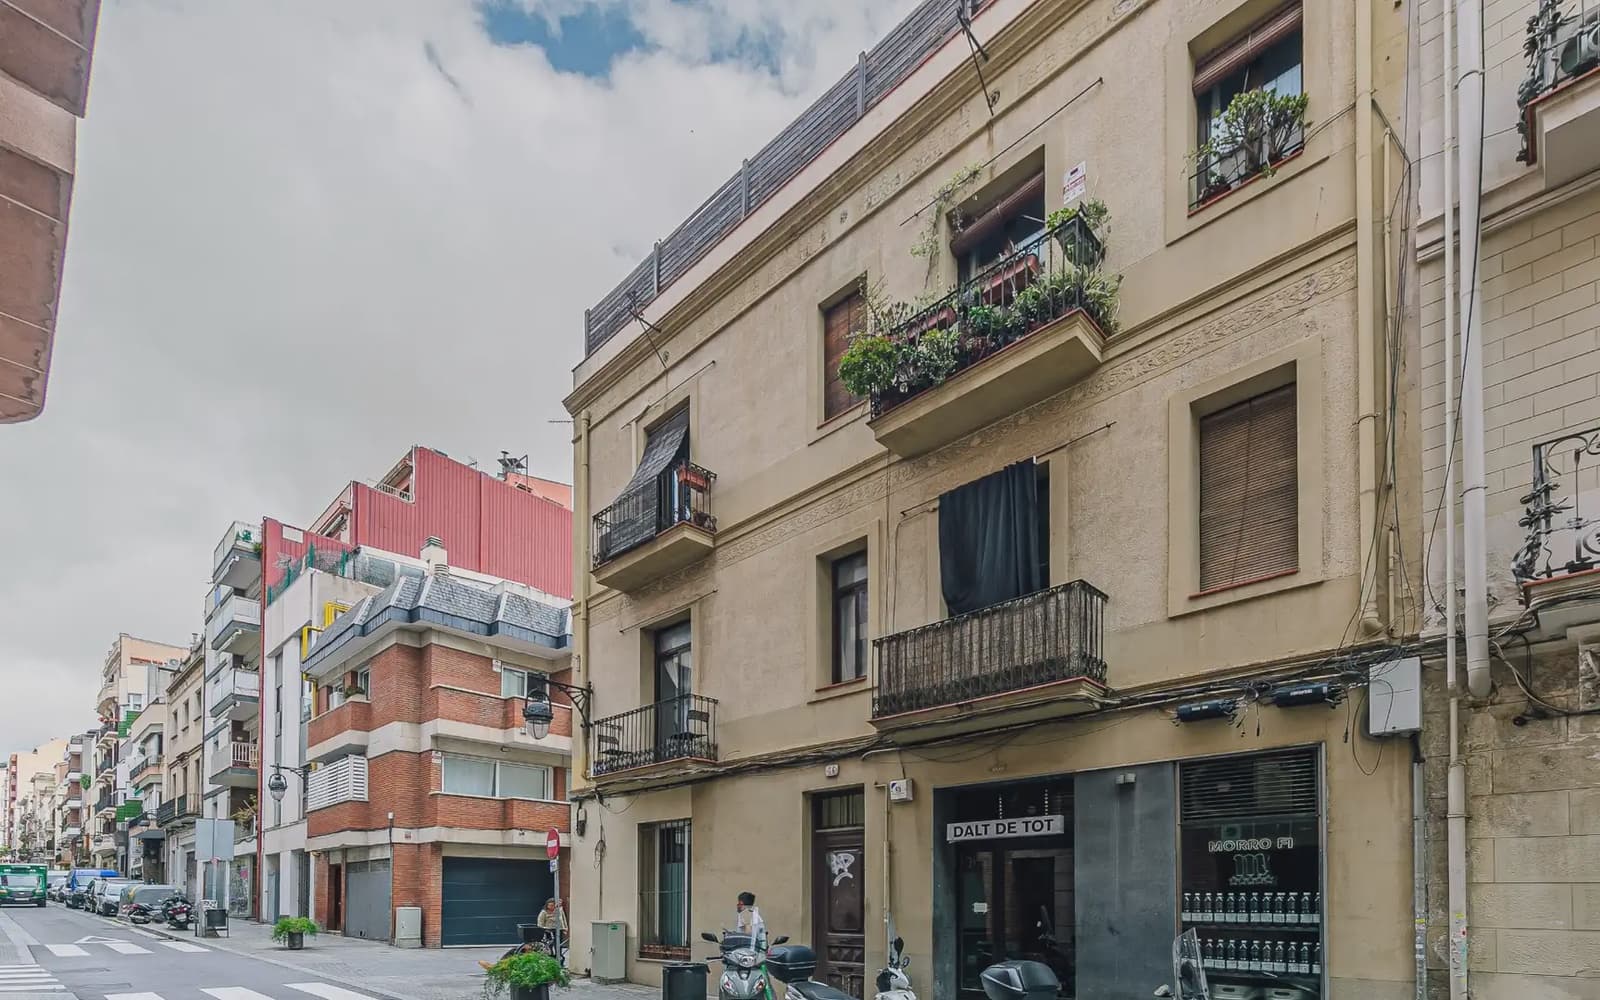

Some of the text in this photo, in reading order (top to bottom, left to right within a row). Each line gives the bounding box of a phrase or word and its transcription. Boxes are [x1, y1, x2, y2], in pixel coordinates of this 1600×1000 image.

[953, 819, 1054, 837] DALT DE TOT
[1208, 837, 1294, 852] MORRO FI
